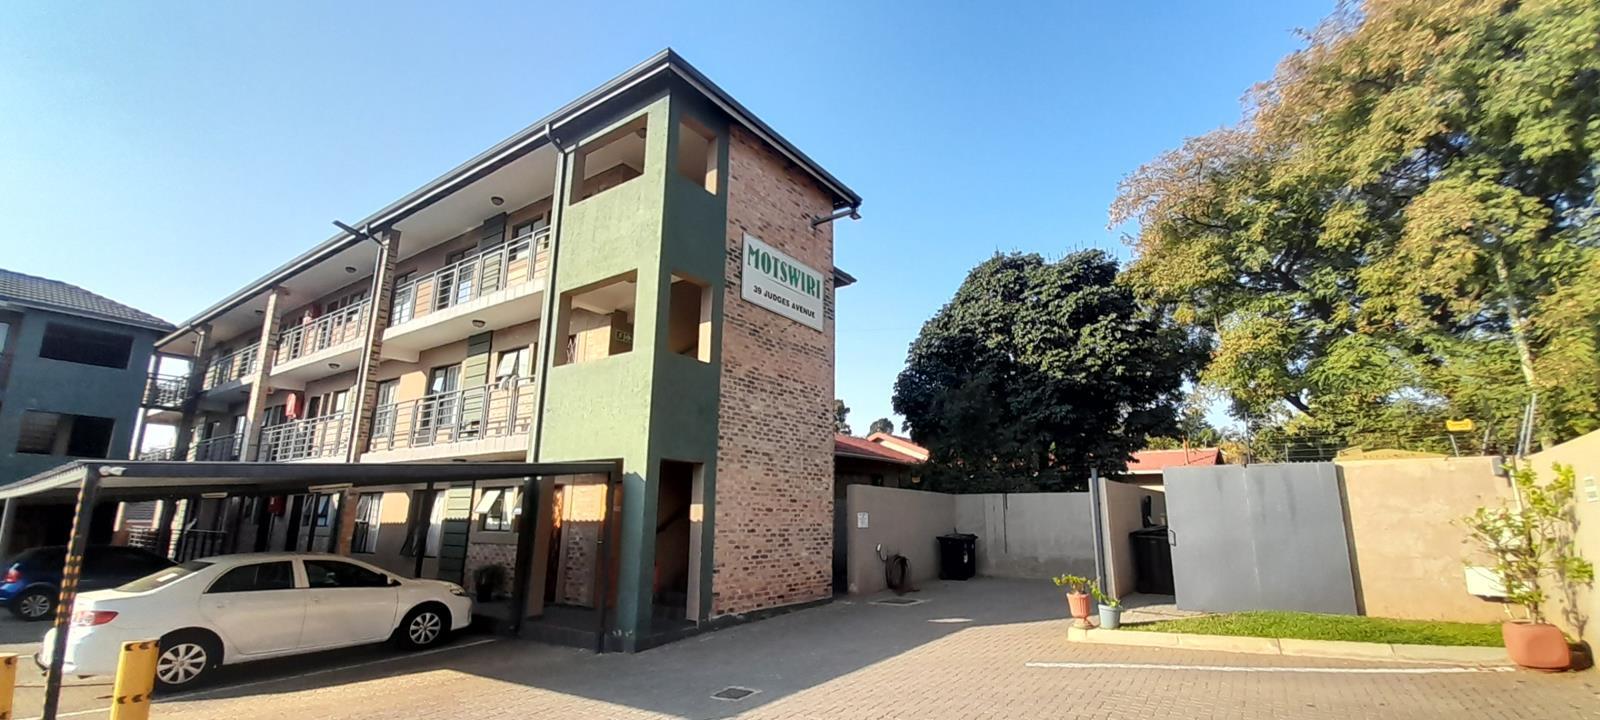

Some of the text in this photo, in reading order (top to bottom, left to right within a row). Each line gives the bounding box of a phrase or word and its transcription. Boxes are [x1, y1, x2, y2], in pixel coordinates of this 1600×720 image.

[747, 244, 820, 299] MOTSWIRI
[753, 285, 816, 319] 39 JUDGES AVENUE
